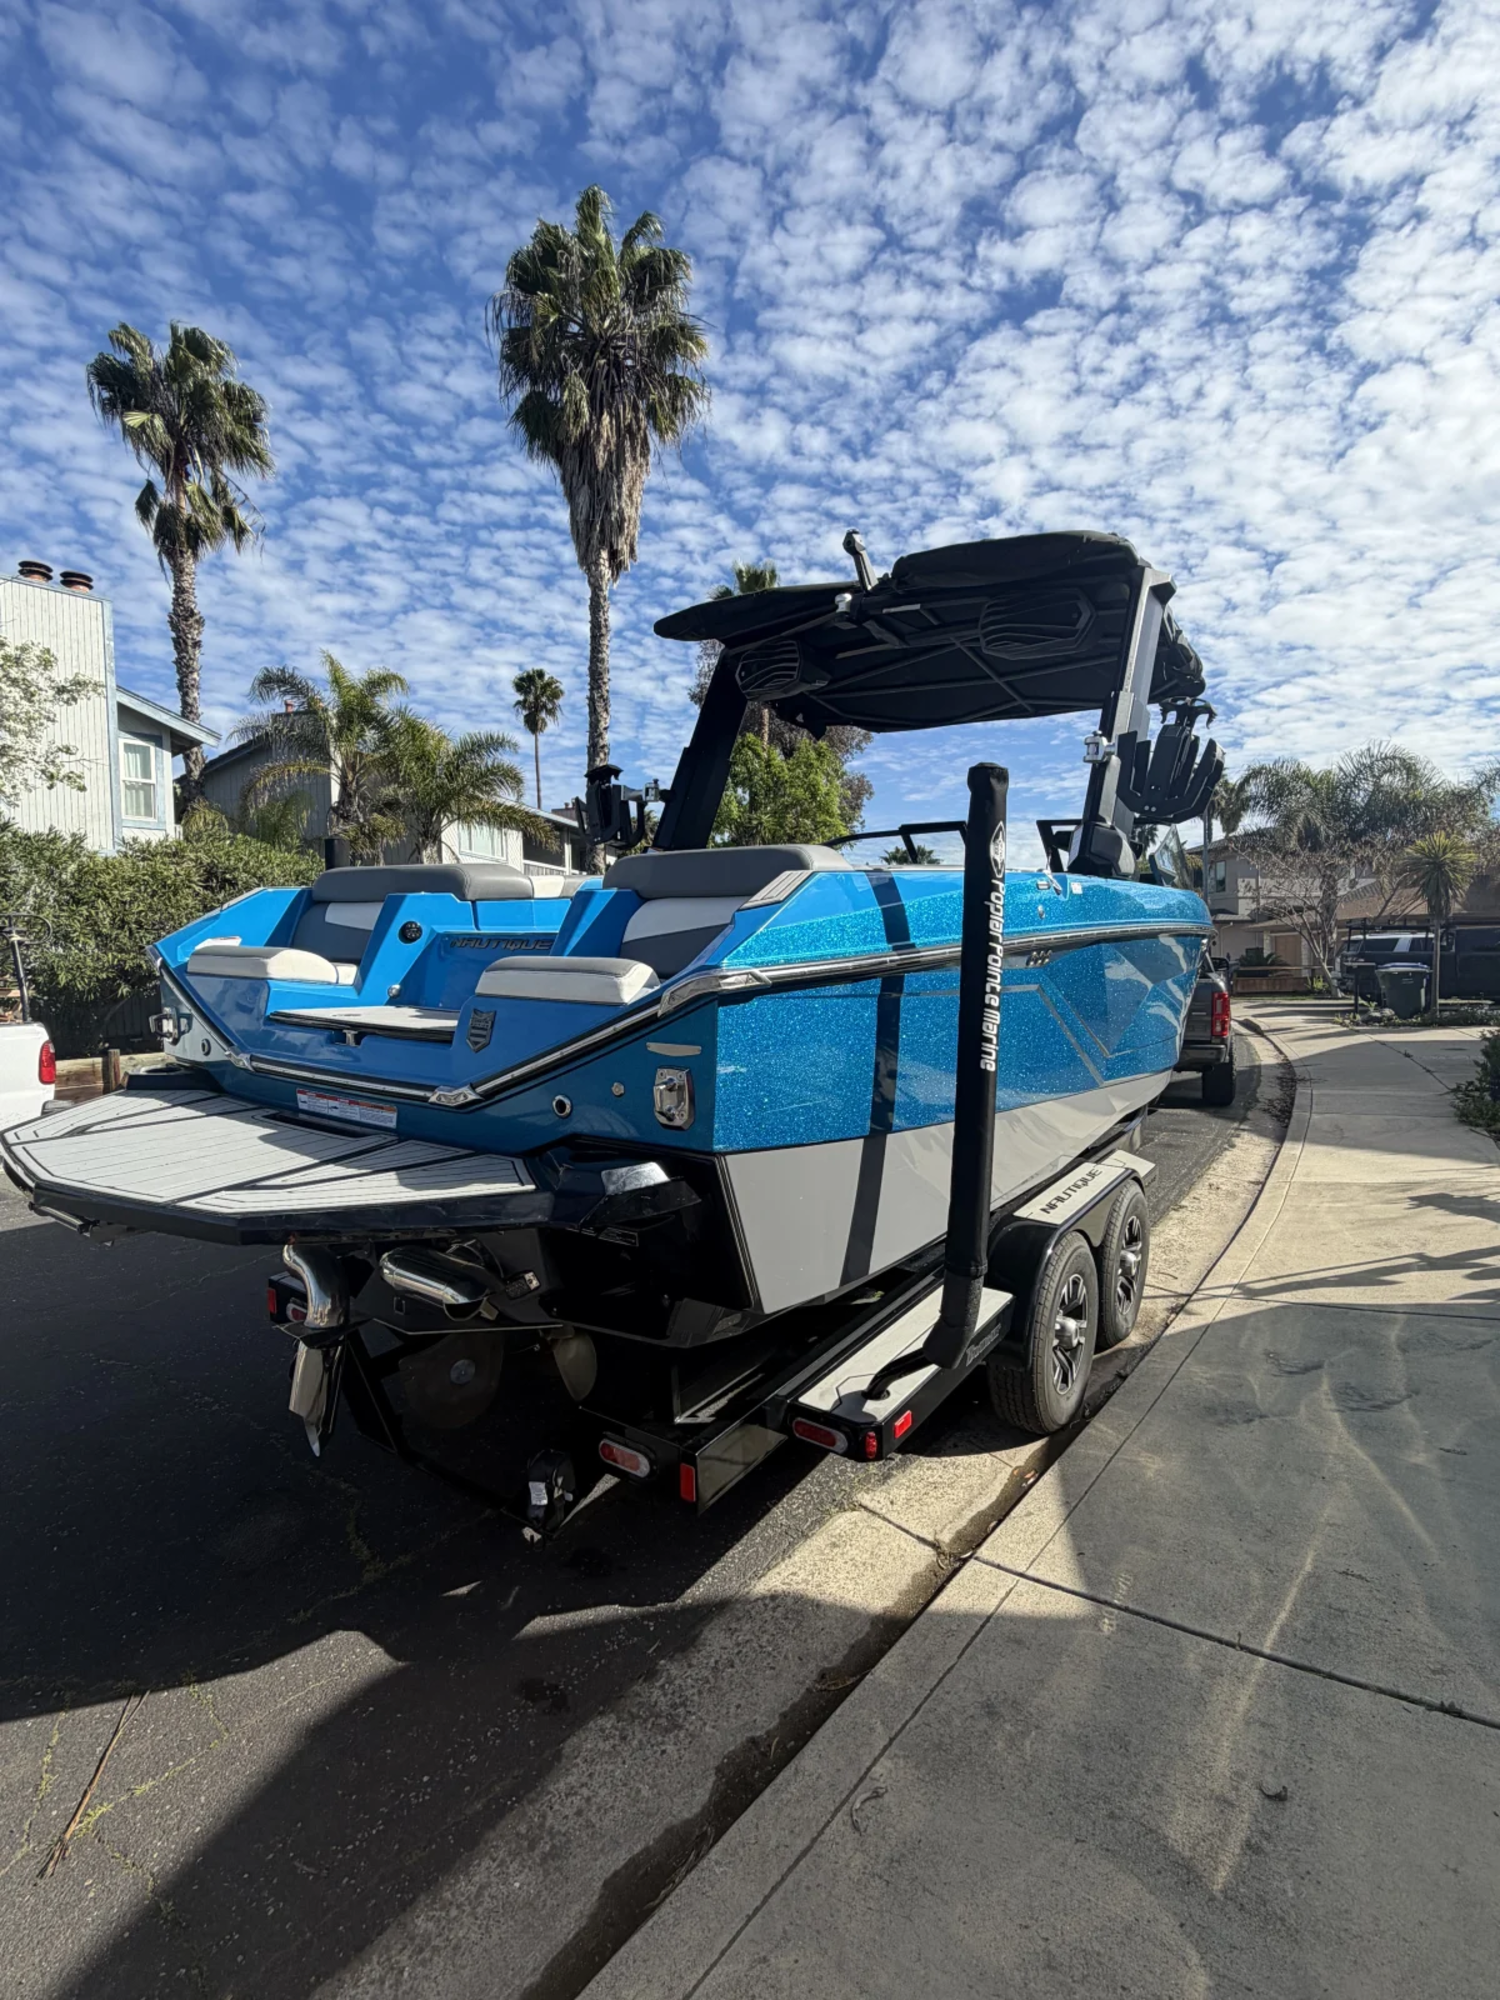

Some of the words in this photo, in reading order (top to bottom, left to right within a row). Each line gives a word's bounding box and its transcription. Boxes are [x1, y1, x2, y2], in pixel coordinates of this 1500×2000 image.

[984, 879, 1005, 943] Poplar
[449, 936, 554, 952] NAUTIQUE
[985, 942, 1003, 1007] Pointe
[980, 1008, 1001, 1072] Marine
[1039, 1167, 1103, 1215] NAUTIQUE
